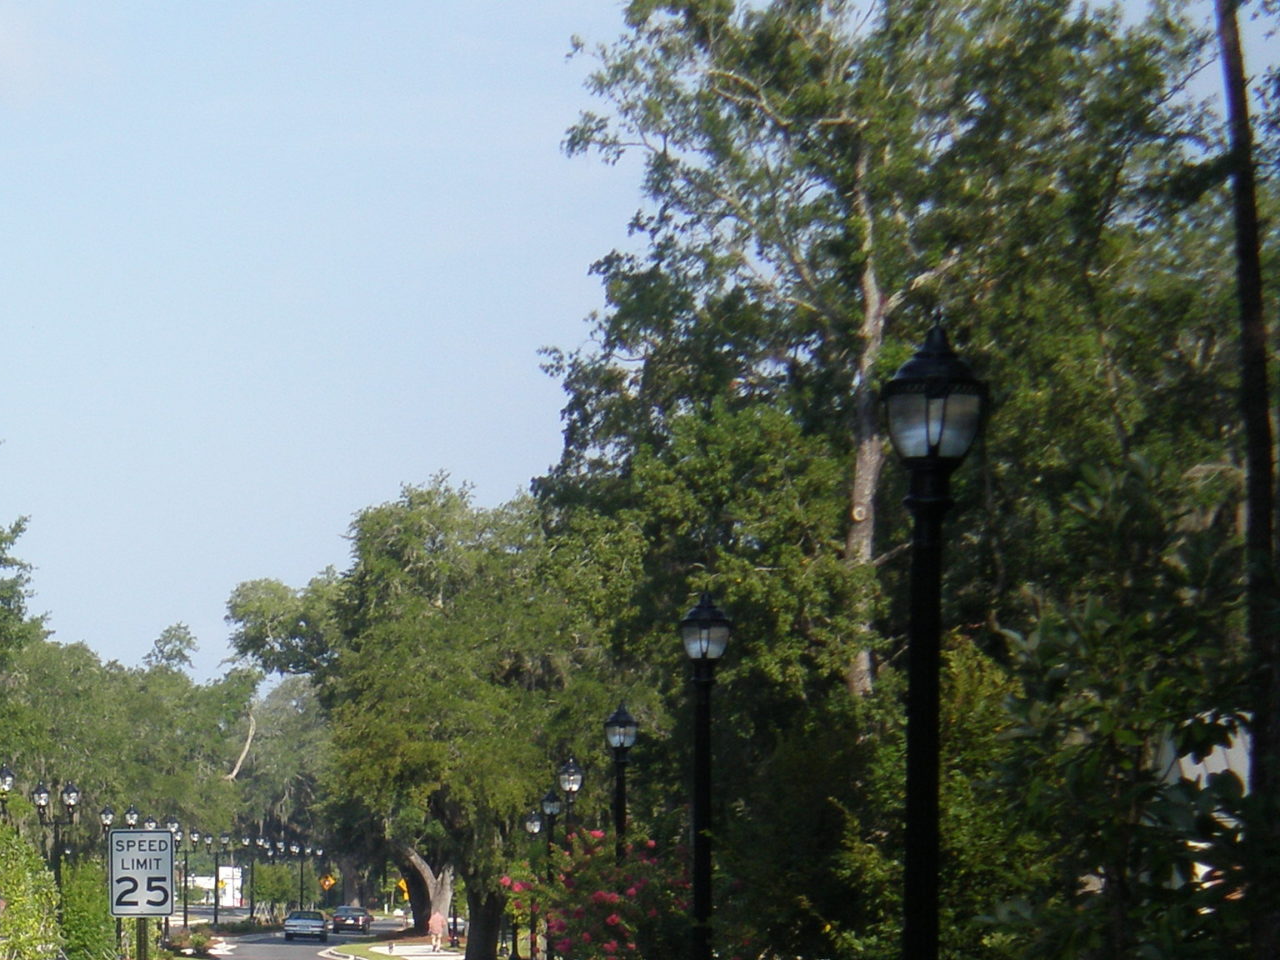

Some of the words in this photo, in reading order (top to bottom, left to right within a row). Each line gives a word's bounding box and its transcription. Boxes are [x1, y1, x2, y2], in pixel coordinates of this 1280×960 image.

[116, 840, 168, 852] SPEED
[121, 858, 162, 871] LIMIT
[115, 876, 169, 906] 25
